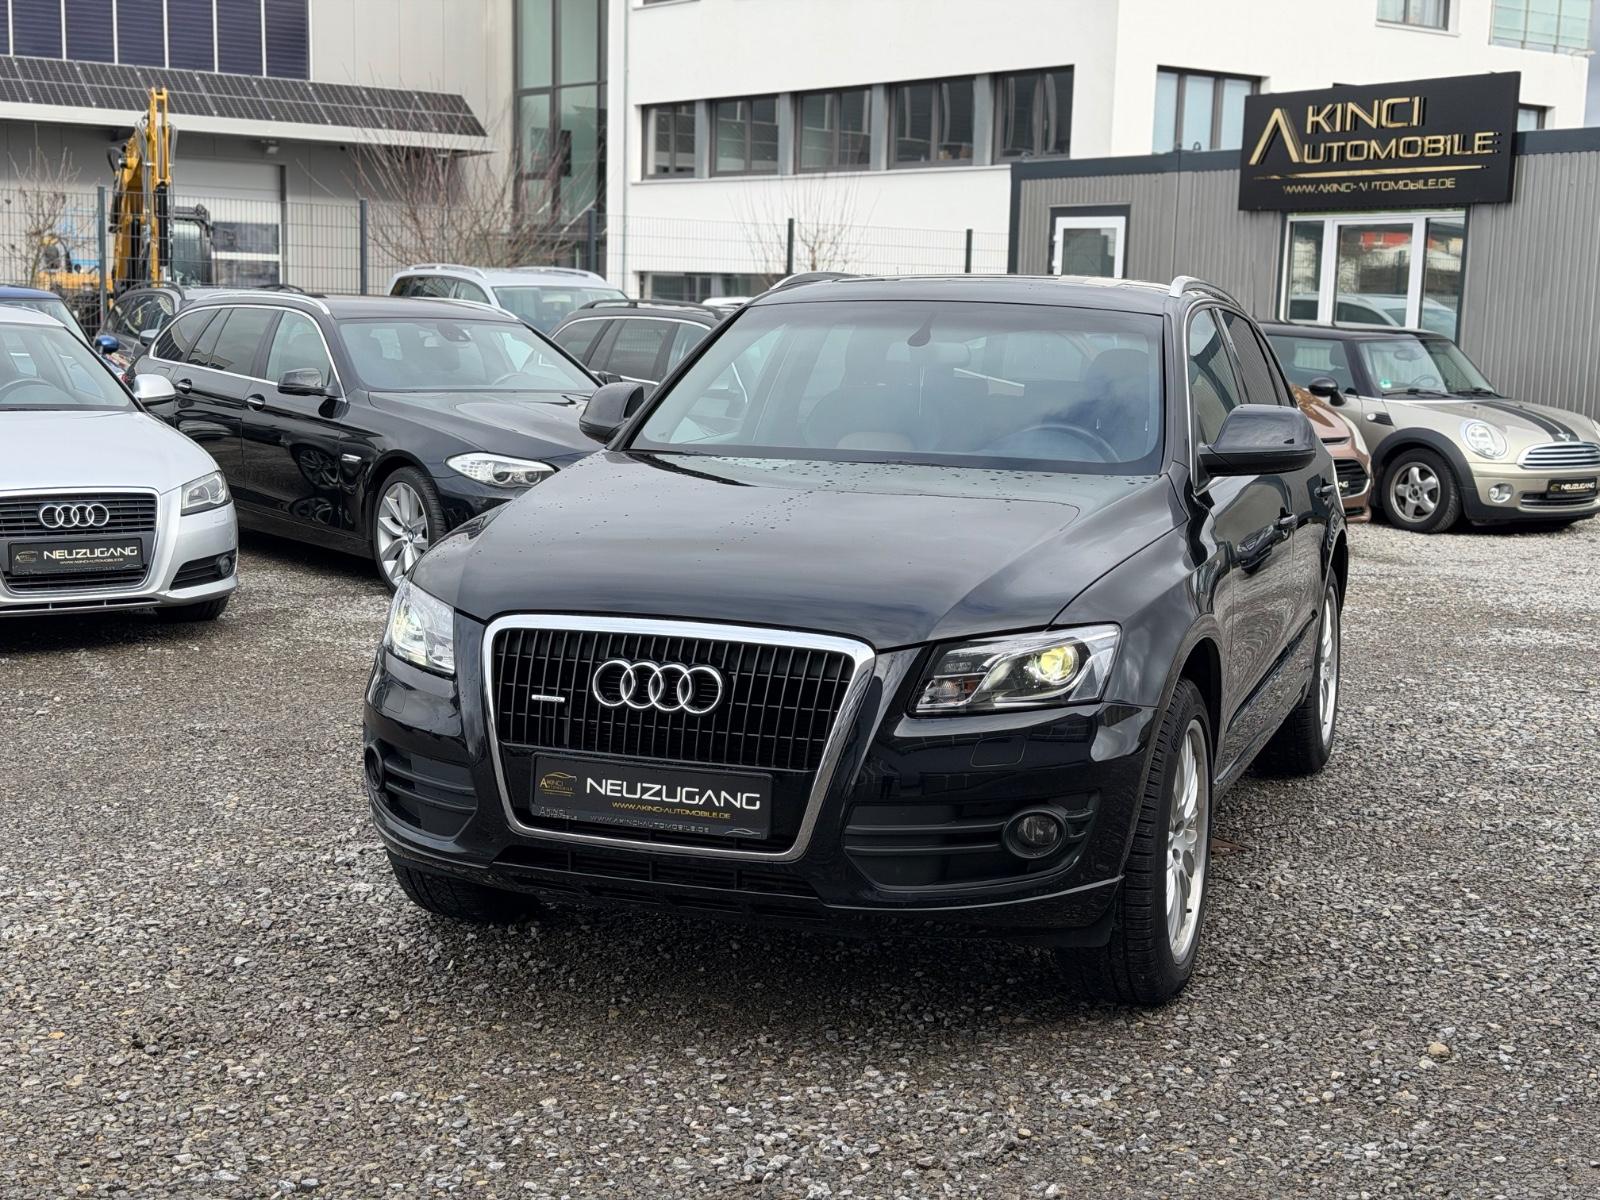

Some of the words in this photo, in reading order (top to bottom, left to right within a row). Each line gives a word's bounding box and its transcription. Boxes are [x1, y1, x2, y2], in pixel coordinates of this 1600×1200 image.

[43, 546, 138, 560] NEUZUGANG
[586, 777, 761, 810] NEUZUGANG
[611, 801, 732, 819] WWW.AKINCI-AUTOMOBILE.DE
